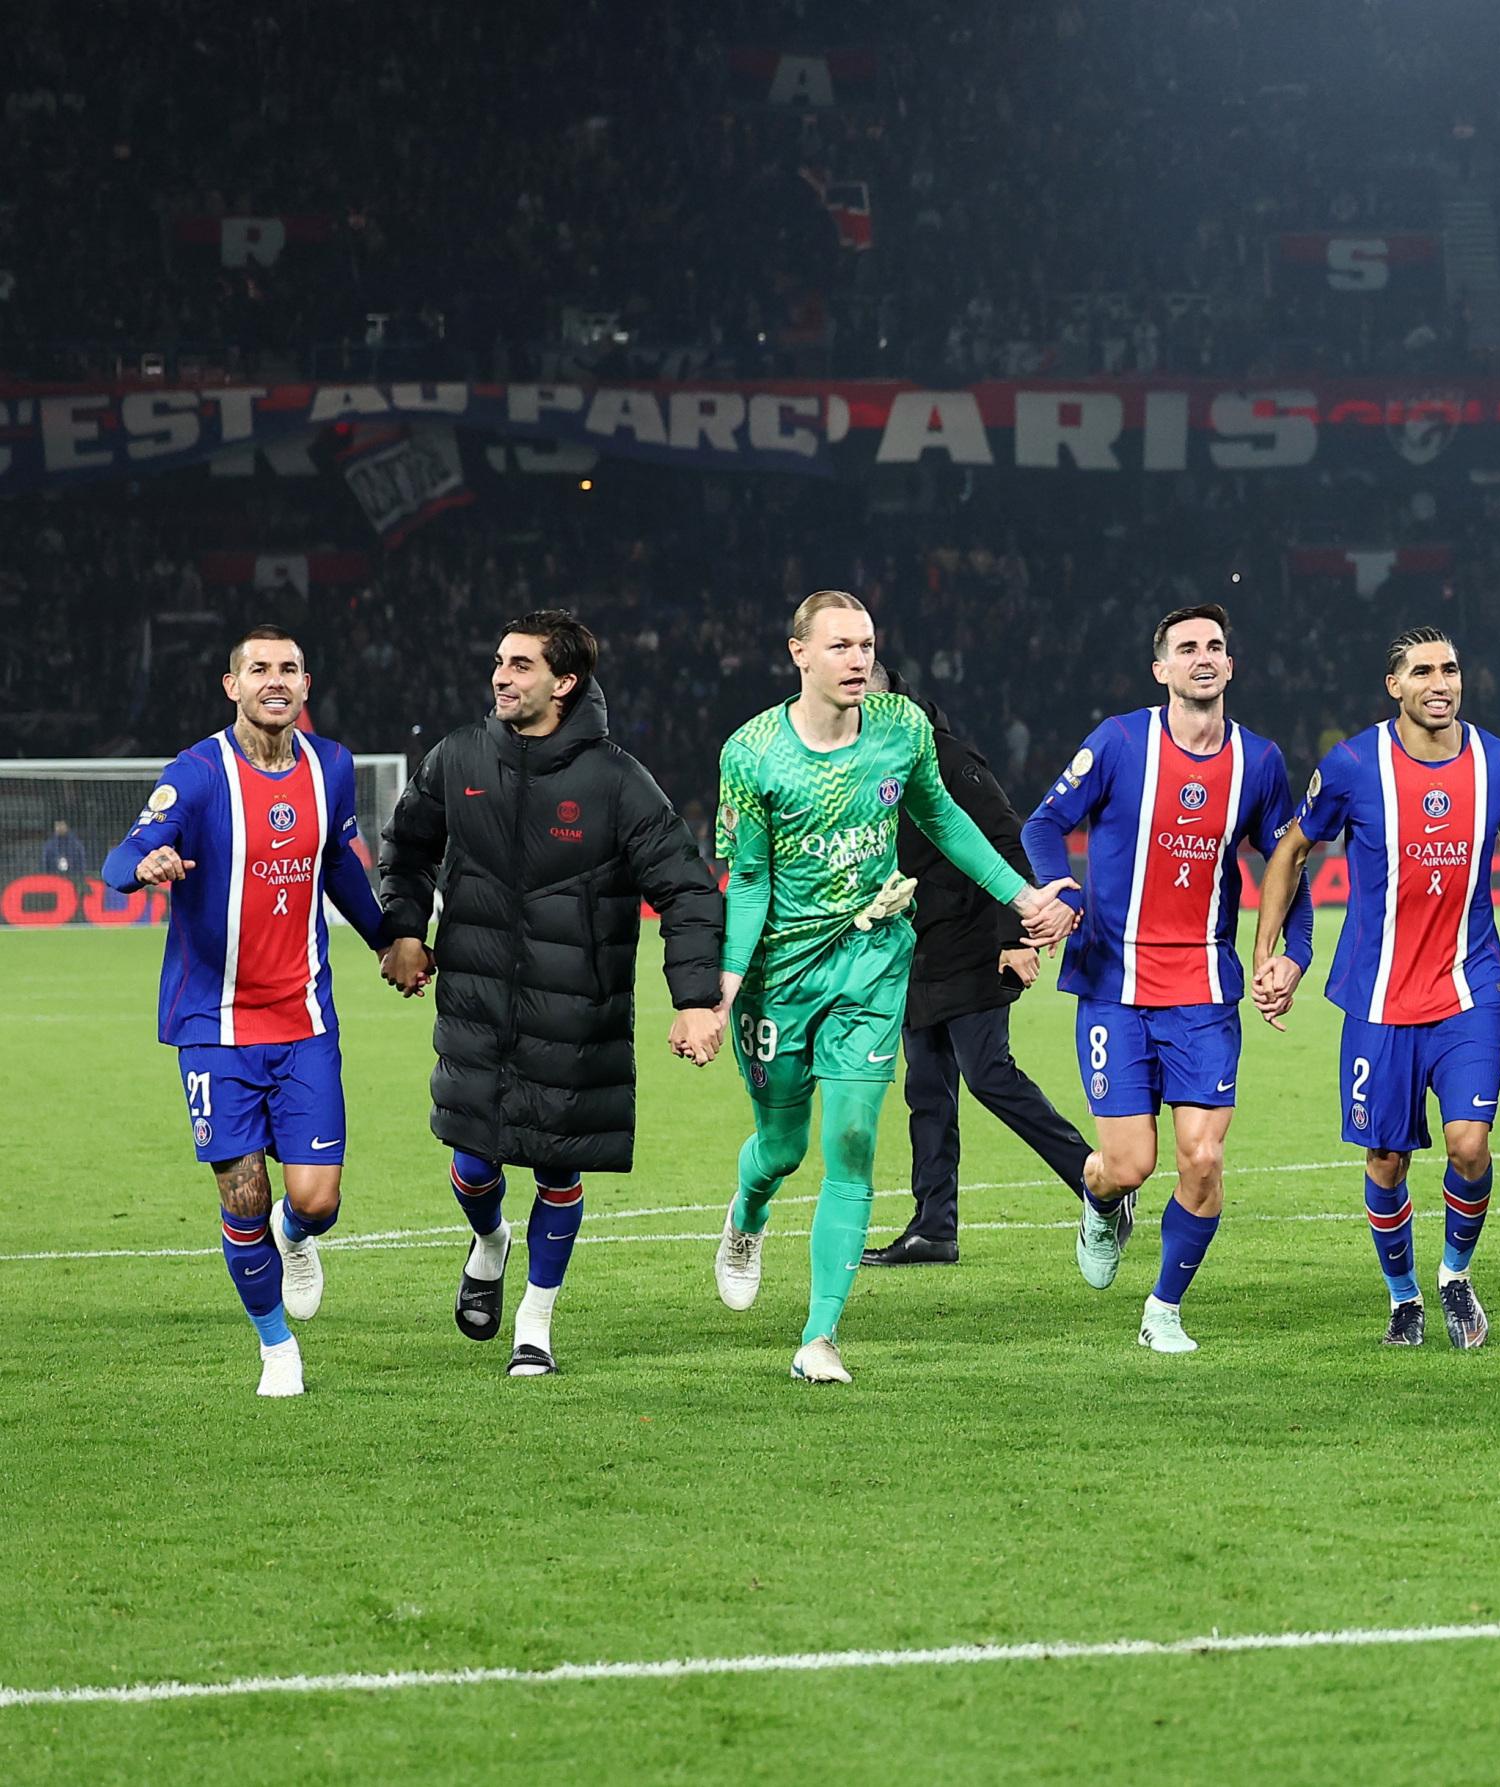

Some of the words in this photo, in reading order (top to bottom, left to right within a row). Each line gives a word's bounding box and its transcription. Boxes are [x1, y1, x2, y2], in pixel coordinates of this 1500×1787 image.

[1326, 238, 1389, 291] S
[507, 383, 819, 458] PARC
[549, 826, 583, 839] QATAR
[801, 820, 889, 859] QATAR
[1157, 832, 1217, 852] QATAR
[1171, 848, 1215, 861] AIRWAYS
[1405, 840, 1468, 858] QATAR
[1421, 855, 1467, 867] AIRWAYS
[251, 856, 312, 878] QATAR
[266, 872, 311, 886] AIRWAYS
[740, 1013, 778, 1062] 39
[1089, 1025, 1108, 1070] 8
[187, 1071, 211, 1117] 21
[1352, 1057, 1370, 1102] 2
